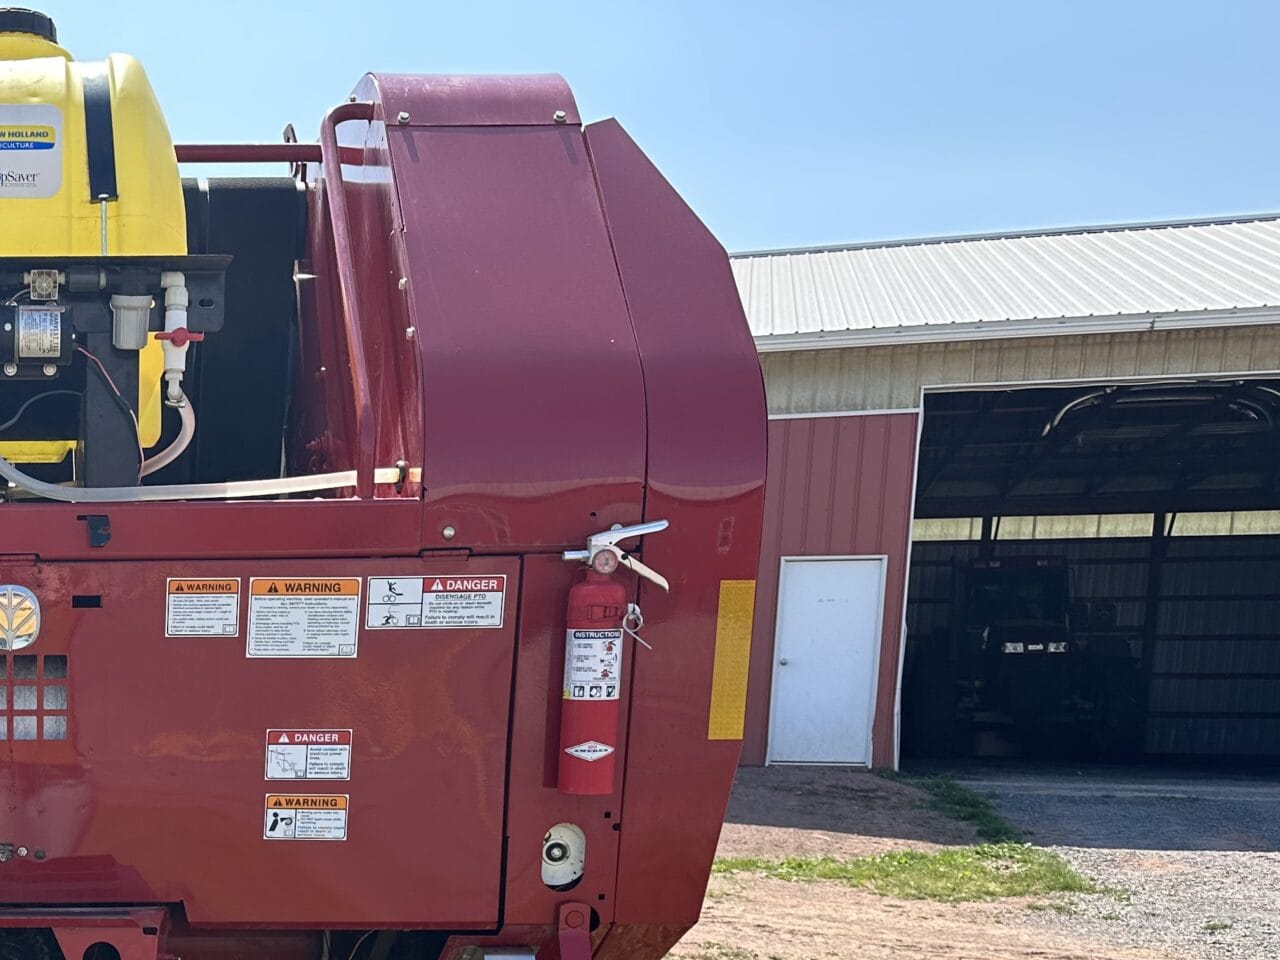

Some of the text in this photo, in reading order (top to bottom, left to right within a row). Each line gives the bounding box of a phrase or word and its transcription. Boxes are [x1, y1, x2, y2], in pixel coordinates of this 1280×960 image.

[186, 583, 232, 591] WARNING
[284, 583, 341, 593] WARNING
[446, 580, 497, 590] DANGER
[294, 733, 339, 742] DANGER
[284, 798, 338, 807] WARNING
